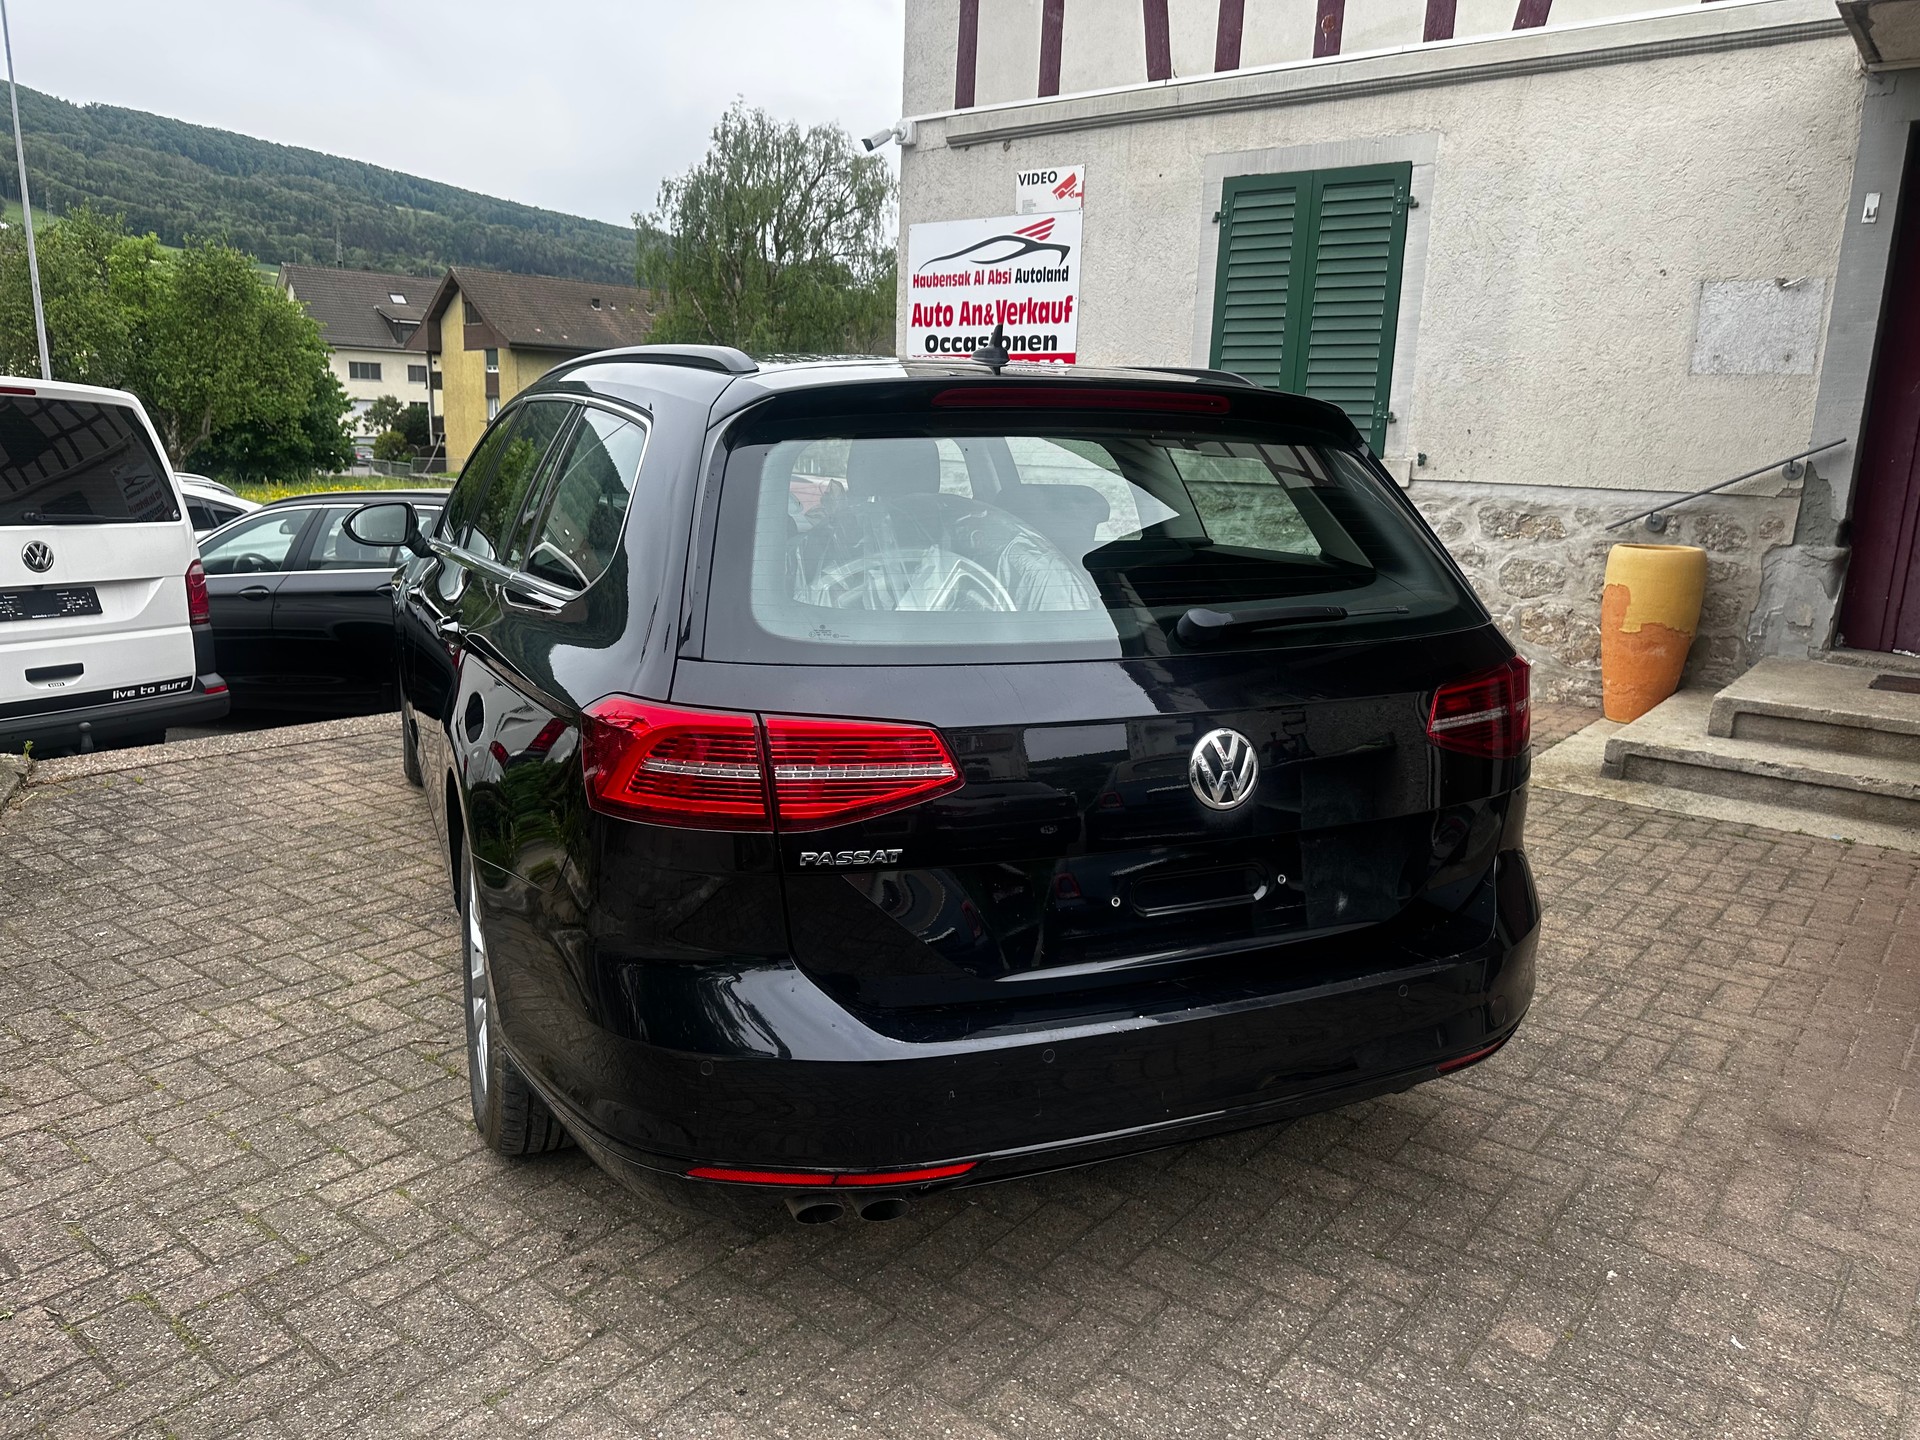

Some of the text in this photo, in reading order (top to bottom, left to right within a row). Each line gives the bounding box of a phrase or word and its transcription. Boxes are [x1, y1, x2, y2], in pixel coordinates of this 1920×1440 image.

[1018, 171, 1058, 187] VIDEO
[913, 265, 1070, 289] Haubensak Al Absi Autoland
[911, 295, 1073, 327] Auto An&Verkauf
[925, 333, 1058, 353] Occasonen
[112, 680, 189, 700] live to surf
[1190, 730, 1258, 810] VW
[799, 848, 904, 867] PASSAT
